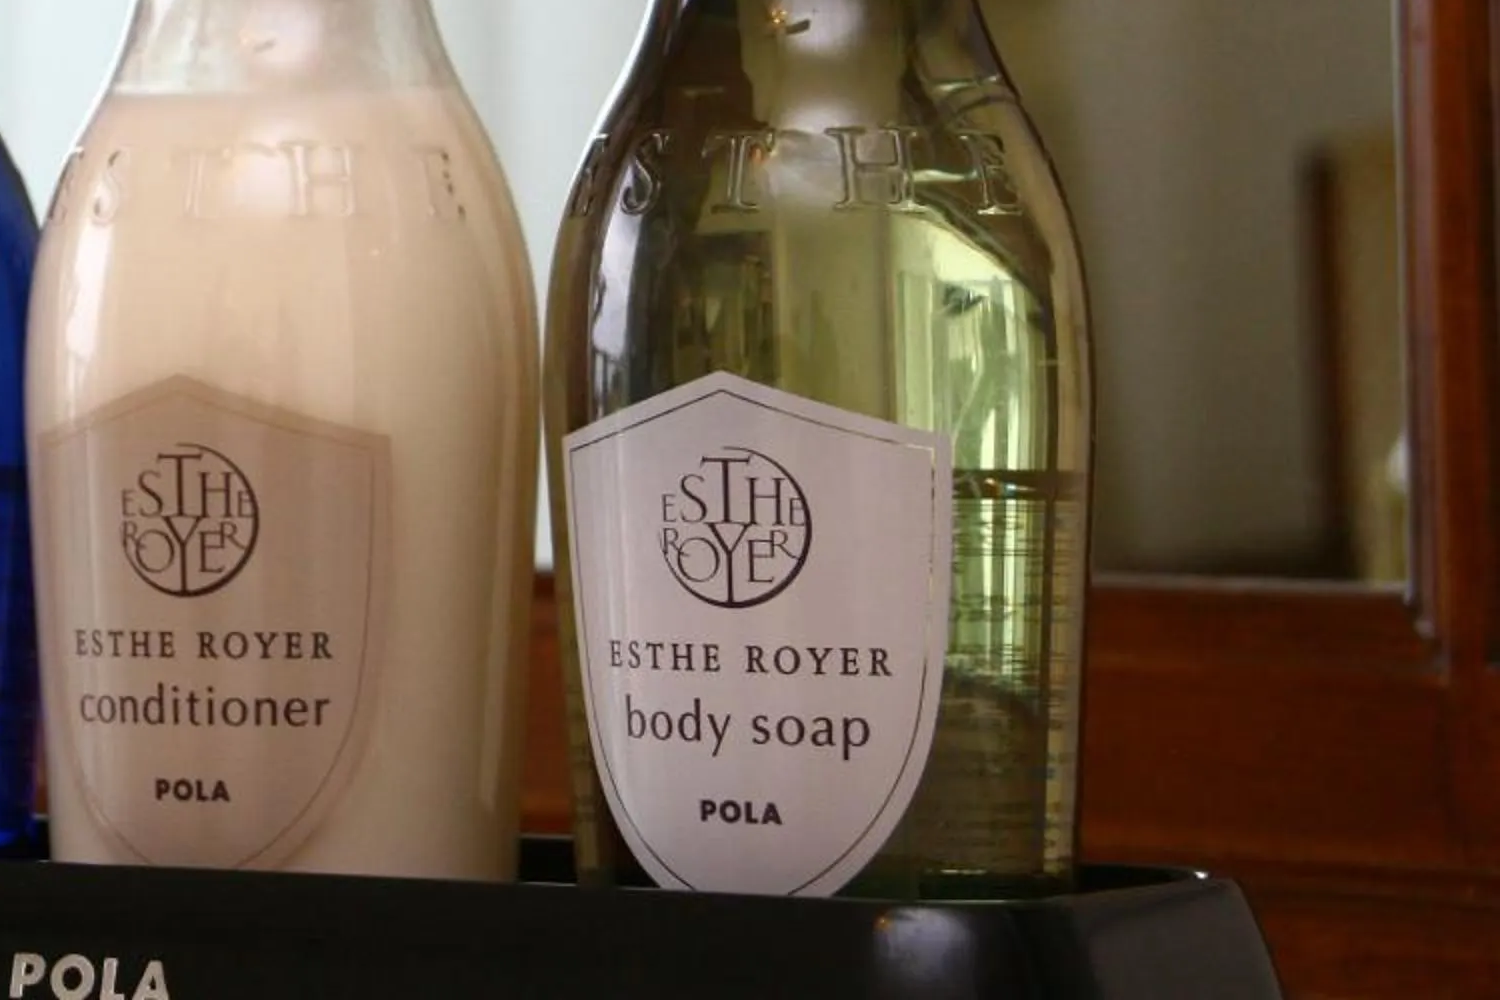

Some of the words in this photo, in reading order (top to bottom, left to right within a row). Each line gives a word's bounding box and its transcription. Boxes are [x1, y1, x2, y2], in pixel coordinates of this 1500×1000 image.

[121, 452, 256, 519] ESTHE
[661, 455, 806, 527] ESTHE
[121, 515, 246, 597] ROYER
[660, 521, 803, 607] ROYER
[75, 629, 176, 658] ESTHE
[196, 630, 333, 660] ROYER
[609, 639, 721, 673] ESTHE
[745, 645, 893, 677] ROYER
[79, 682, 332, 727] conditioner
[625, 694, 731, 758] body
[751, 712, 871, 761] soap
[155, 778, 231, 802] POLA
[700, 800, 783, 826] POLA
[9, 952, 171, 1000] POLA
